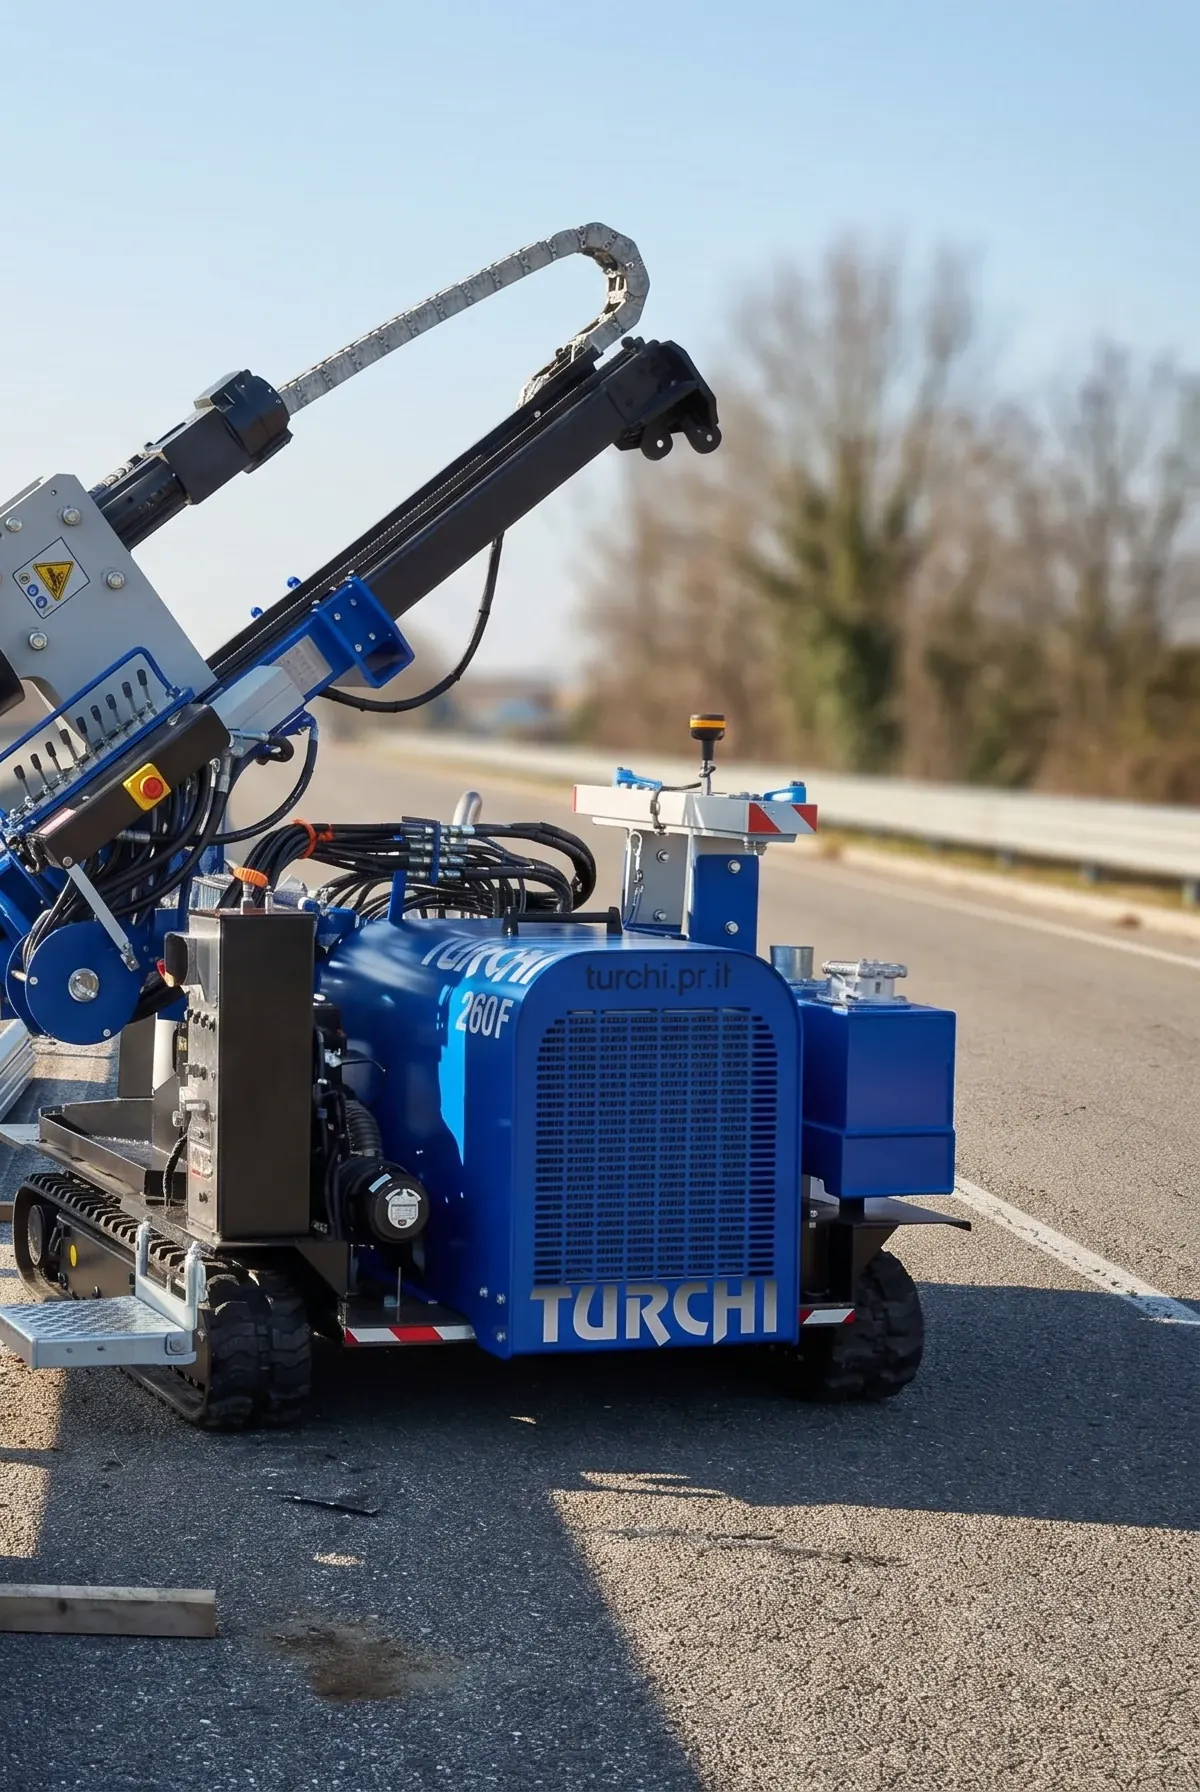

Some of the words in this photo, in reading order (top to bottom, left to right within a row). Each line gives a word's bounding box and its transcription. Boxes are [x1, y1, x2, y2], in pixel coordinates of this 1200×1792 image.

[585, 961, 732, 996] turchi.pr.it
[455, 990, 514, 1039] 260F
[530, 1280, 778, 1347] TURCHI
